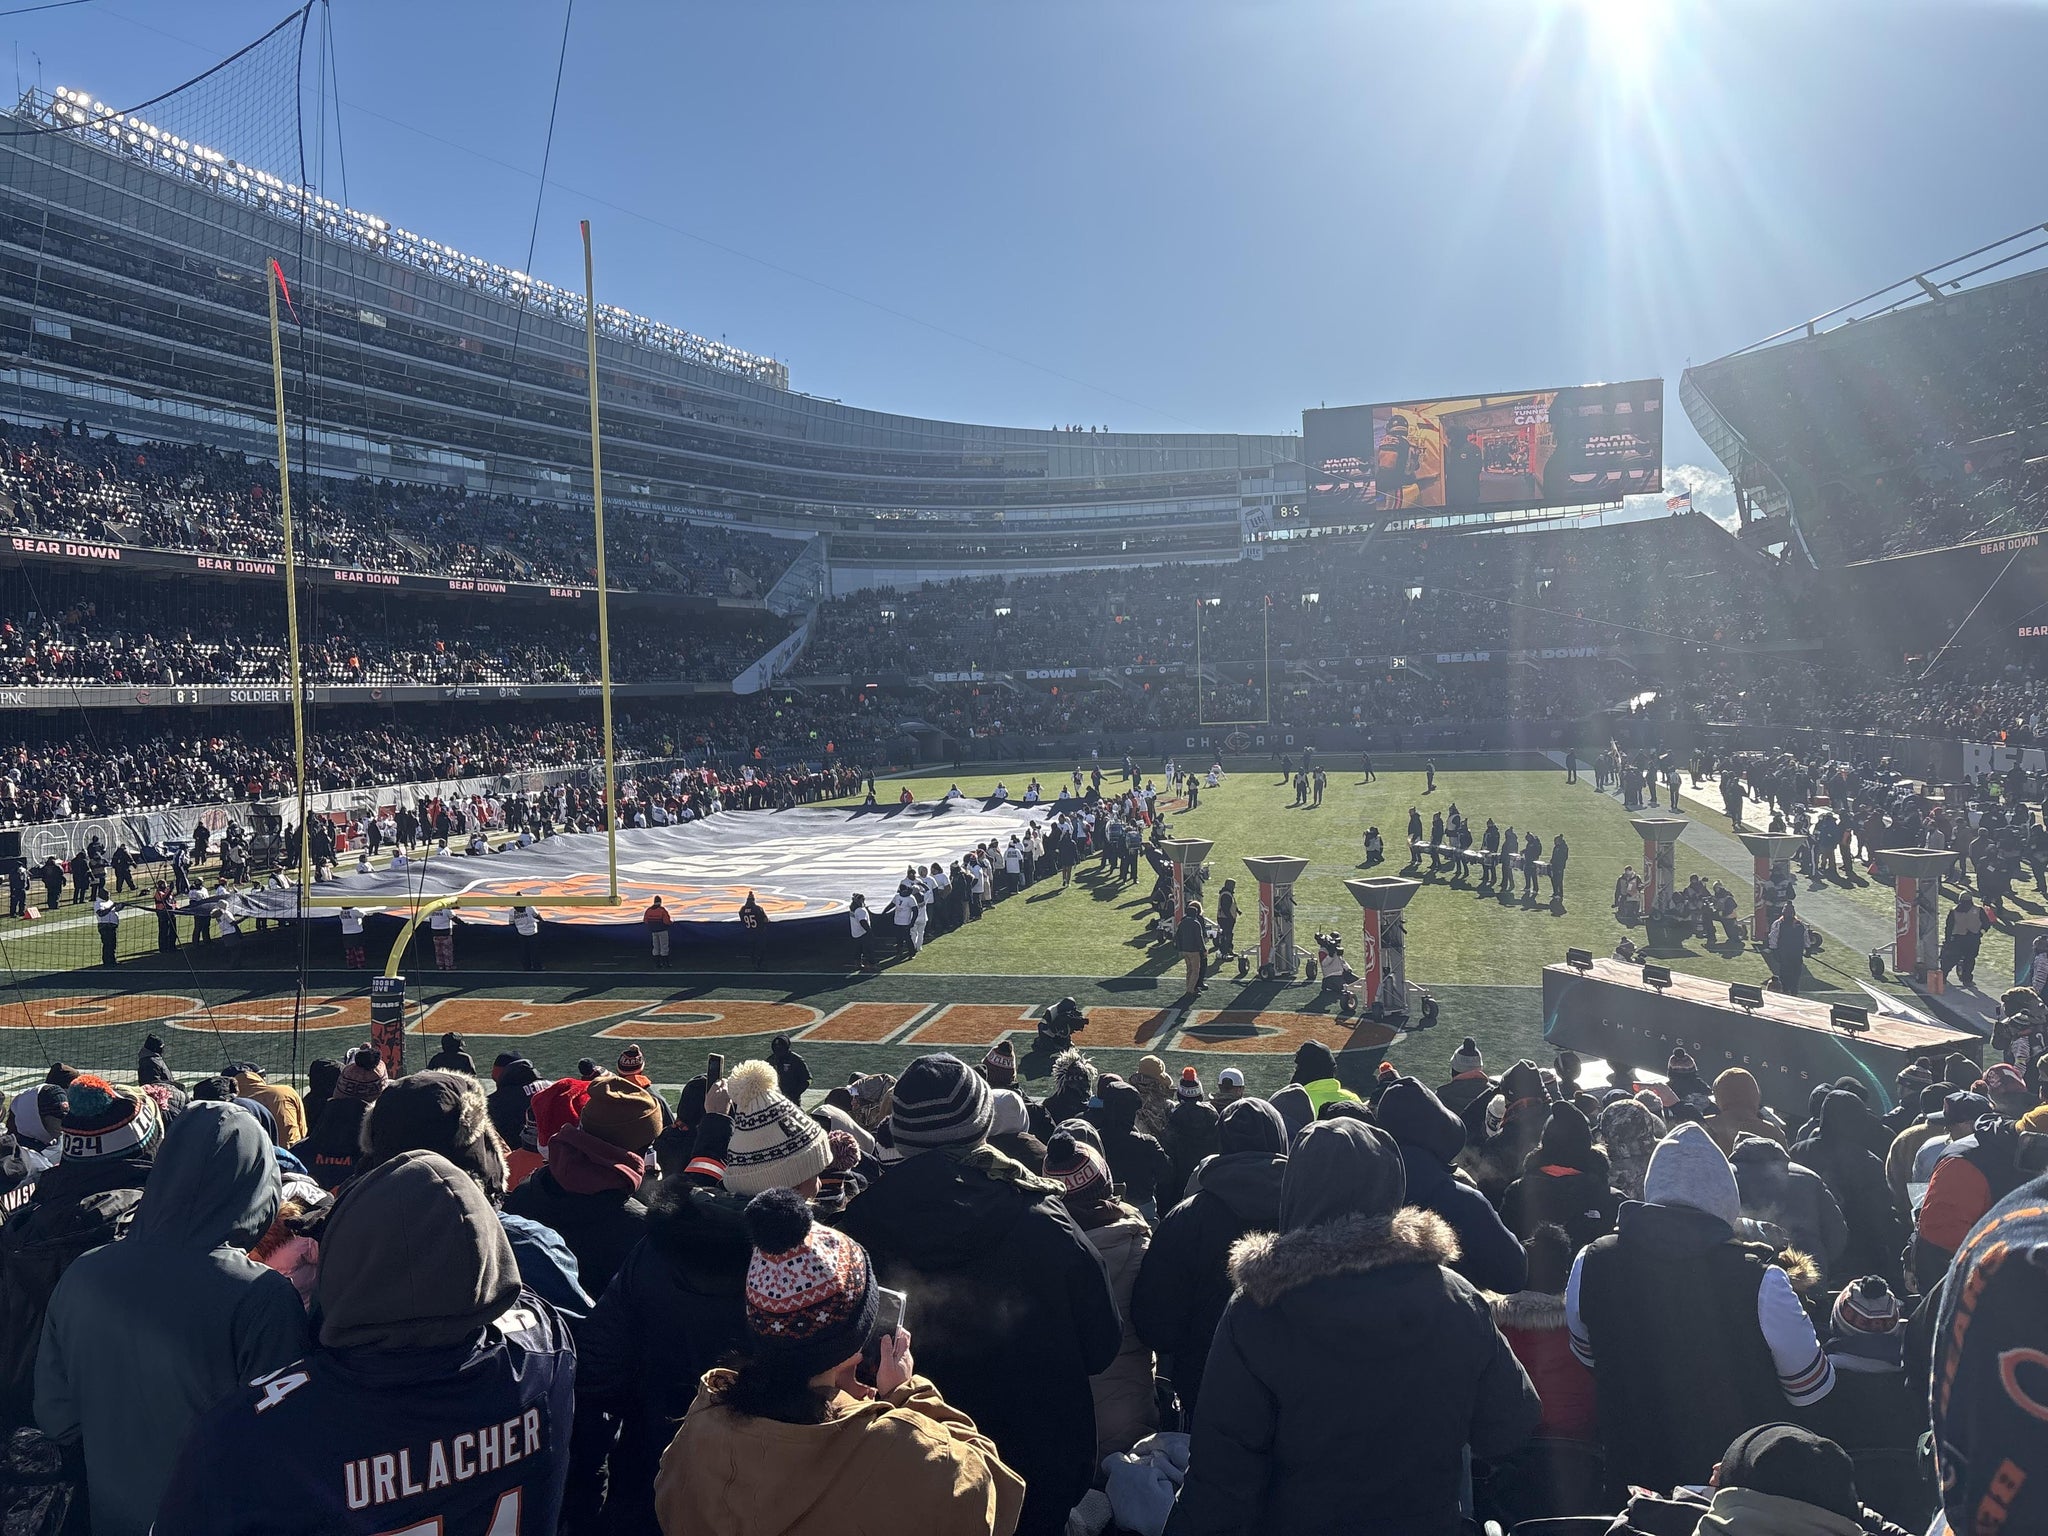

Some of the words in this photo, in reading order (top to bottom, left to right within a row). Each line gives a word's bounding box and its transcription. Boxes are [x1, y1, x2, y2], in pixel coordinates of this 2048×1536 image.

[1515, 415, 1549, 425] CAM
[12, 538, 60, 554] BEAR
[66, 544, 120, 560] DOWN
[1980, 541, 2006, 554] BEAR
[2008, 535, 2039, 550] DOWN
[198, 557, 232, 572] BEAR
[236, 561, 276, 575] DOWN
[334, 570, 364, 583] BEAR
[366, 572, 400, 586] DOWN
[449, 580, 475, 591] BEAR
[477, 582, 506, 593] DOWN
[550, 588, 573, 597] BEAR
[2018, 625, 2048, 637] BEAR
[1392, 657, 1405, 668] 34
[1436, 651, 1491, 664] BEAR
[1541, 647, 1599, 660] DOWN
[933, 671, 985, 682] BEAR
[1026, 668, 1077, 680] DOWN
[230, 690, 279, 702] SOLDIER
[506, 687, 521, 697] PNC
[743, 914, 758, 929] 95
[1602, 1018, 1701, 1051] CHICAGO
[1725, 1051, 1809, 1081] BEARS
[343, 1406, 542, 1512] URLACHER
